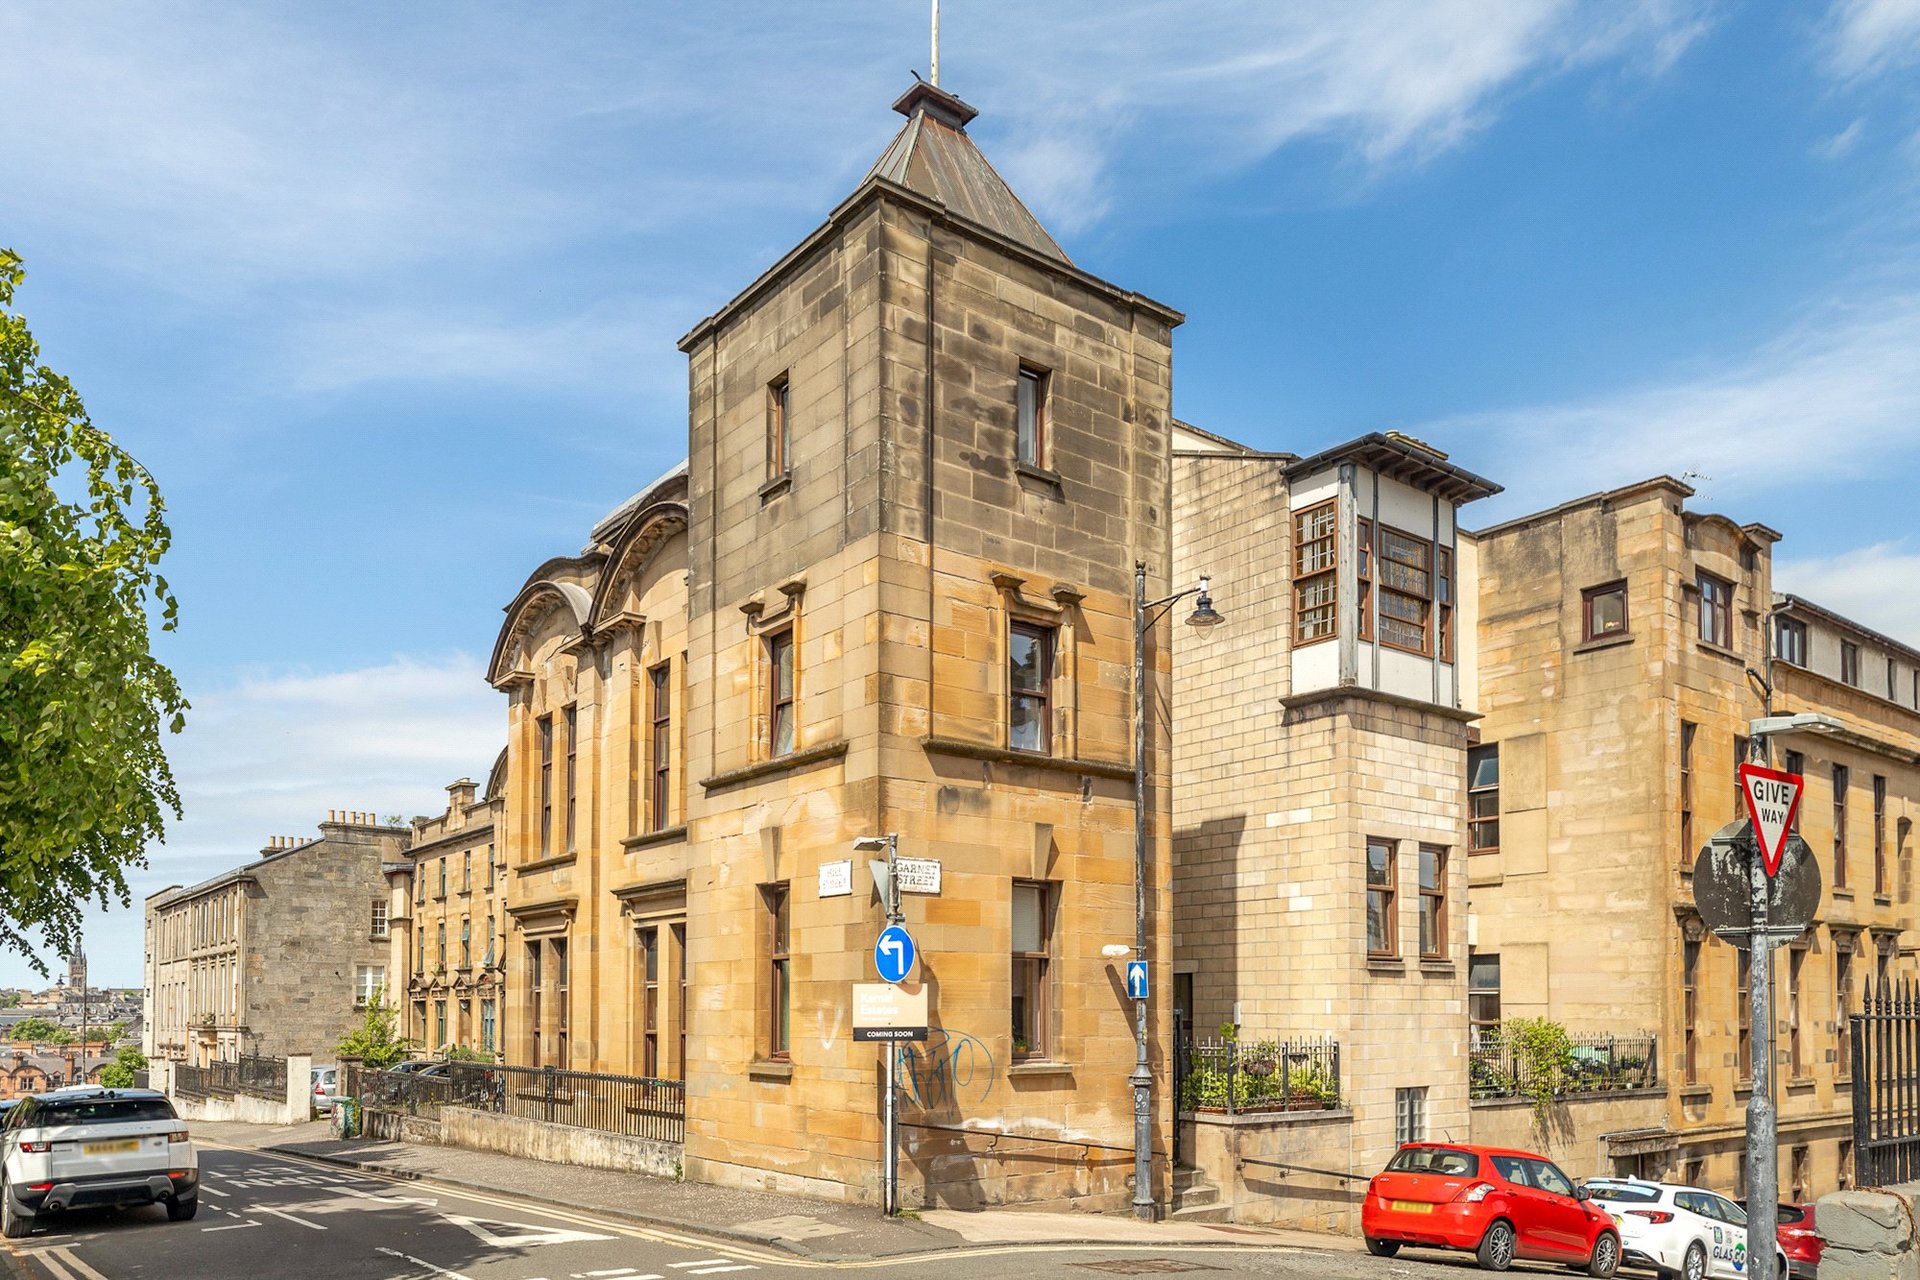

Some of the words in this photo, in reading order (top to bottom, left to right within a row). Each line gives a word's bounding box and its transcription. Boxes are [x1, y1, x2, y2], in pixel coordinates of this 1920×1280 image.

[1753, 780, 1790, 805] GIVE
[1761, 808, 1784, 825] WAY
[898, 874, 935, 886] STREET
